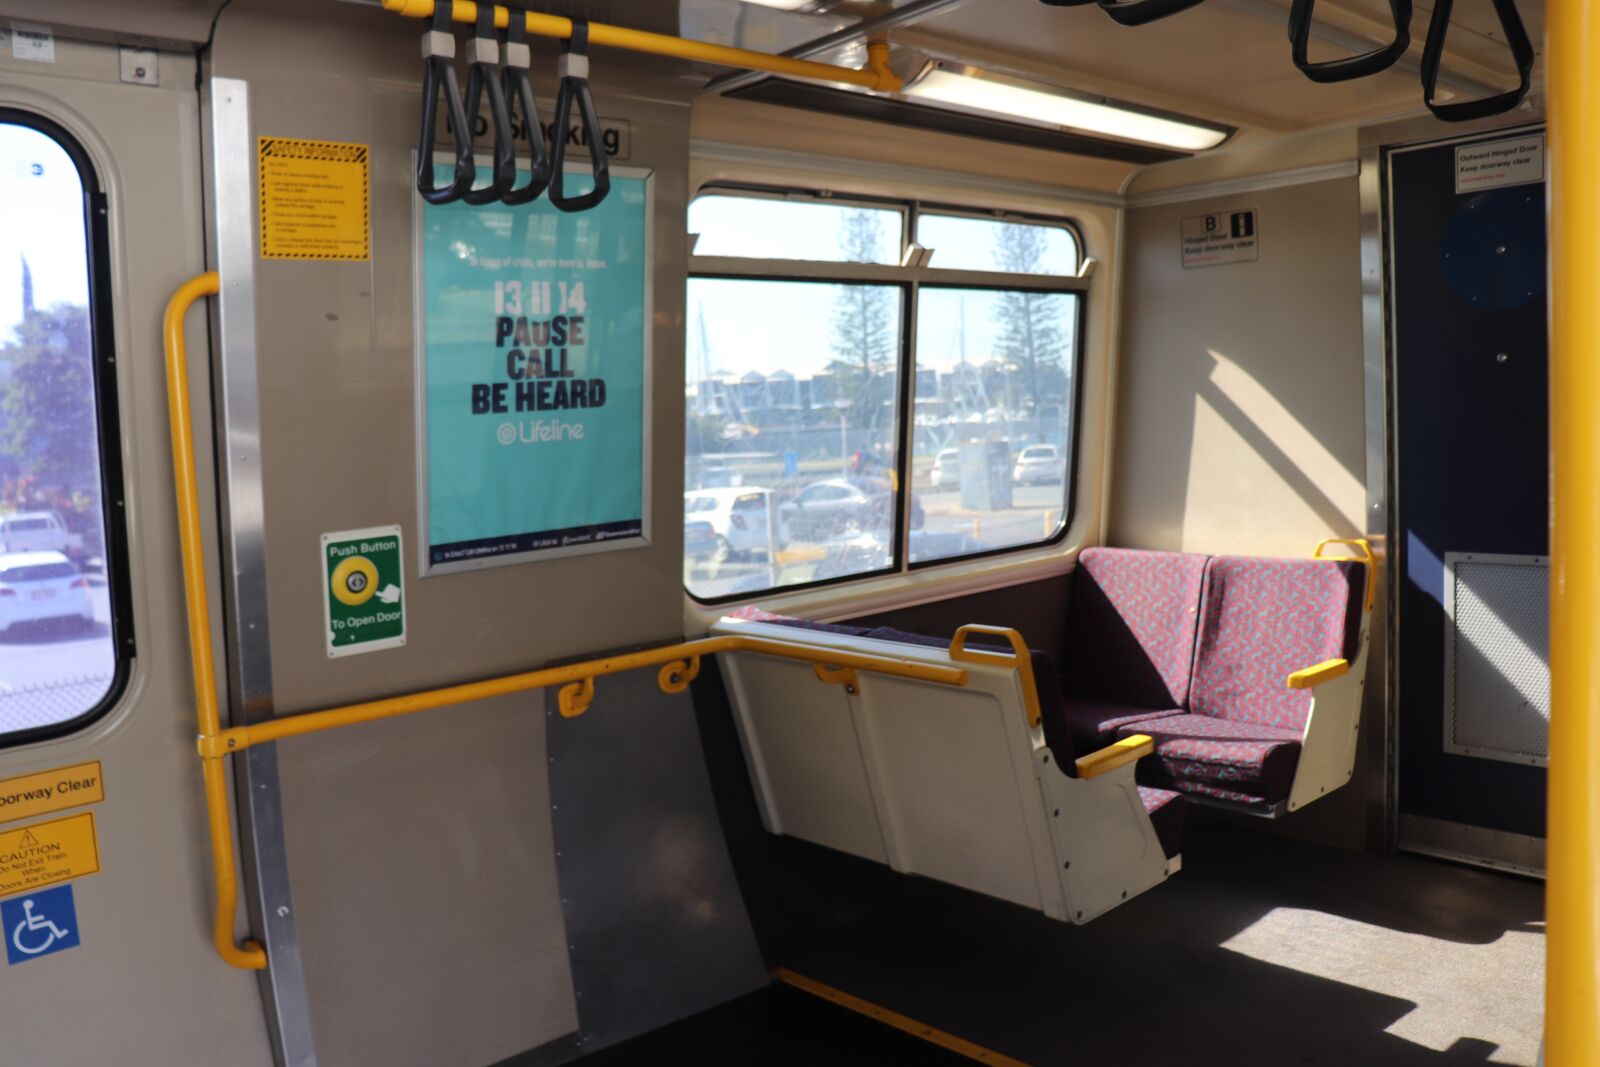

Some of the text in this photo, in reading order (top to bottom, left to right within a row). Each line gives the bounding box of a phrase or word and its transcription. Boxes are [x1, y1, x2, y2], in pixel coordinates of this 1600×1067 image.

[1460, 145, 1538, 162] Outward Hinged Door
[1460, 157, 1531, 173] Keep doorway clear
[1205, 216, 1216, 231] B
[495, 280, 523, 315] 13
[495, 315, 585, 348] PAUSE
[507, 348, 575, 381] CALL
[472, 378, 607, 415] BE HEARD
[520, 419, 585, 444] Lifeline
[330, 541, 396, 557] Push Button
[332, 611, 401, 630] To Open Door
[0, 777, 97, 807] oorway Clear
[0, 842, 60, 864] CAUTION
